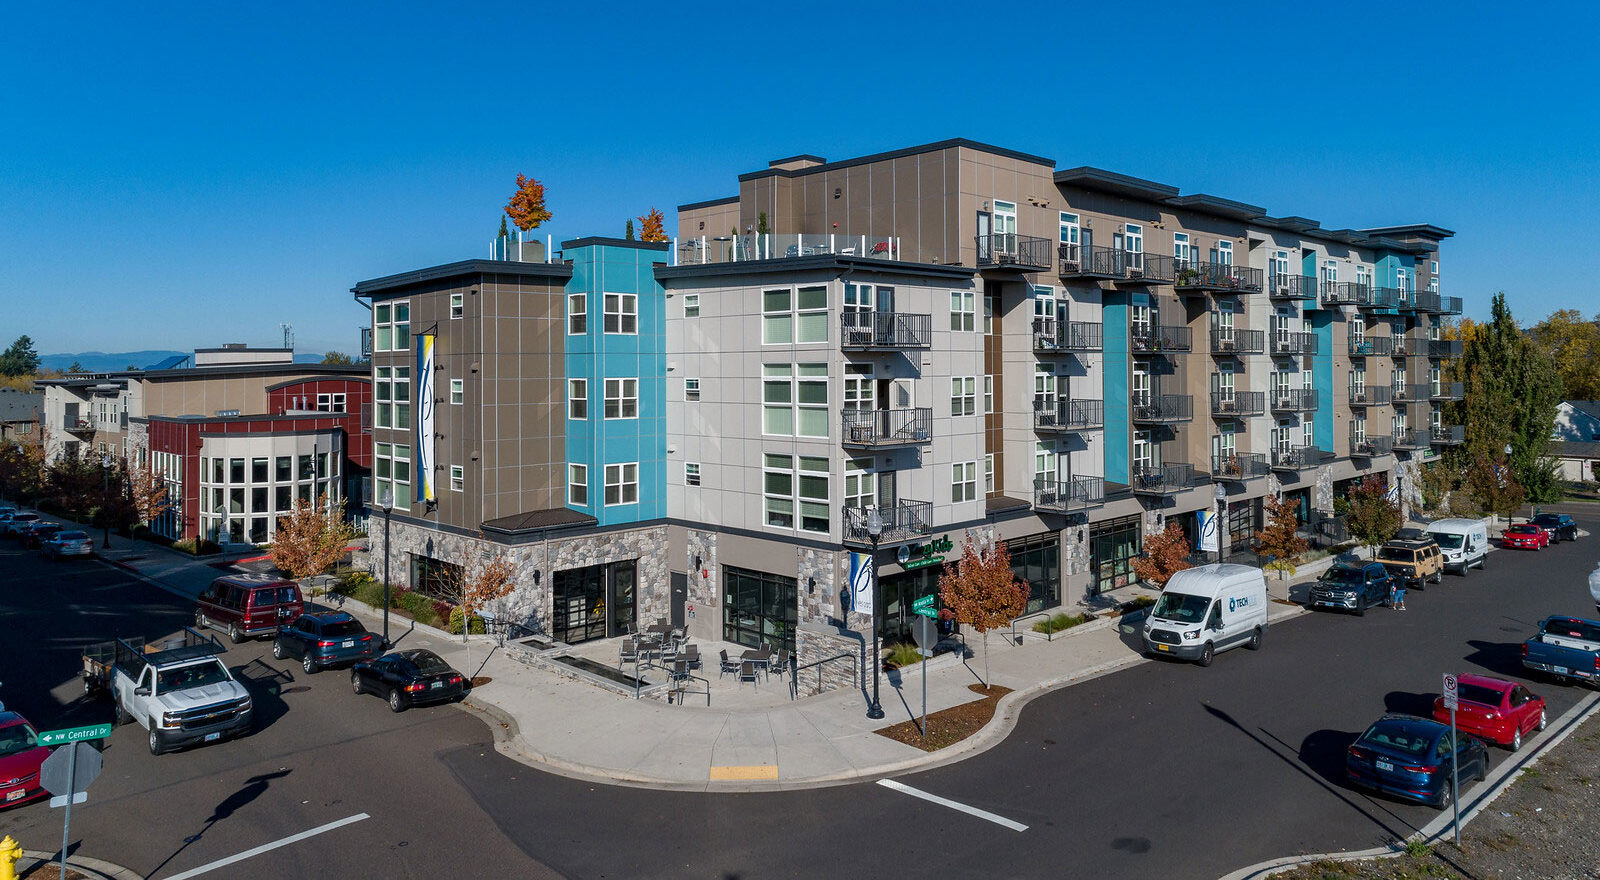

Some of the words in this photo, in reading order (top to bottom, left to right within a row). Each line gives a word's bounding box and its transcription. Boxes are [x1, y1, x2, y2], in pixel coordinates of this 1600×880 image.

[1236, 597, 1249, 608] TECH
[68, 728, 97, 739] Central
[99, 727, 107, 735] Dr
